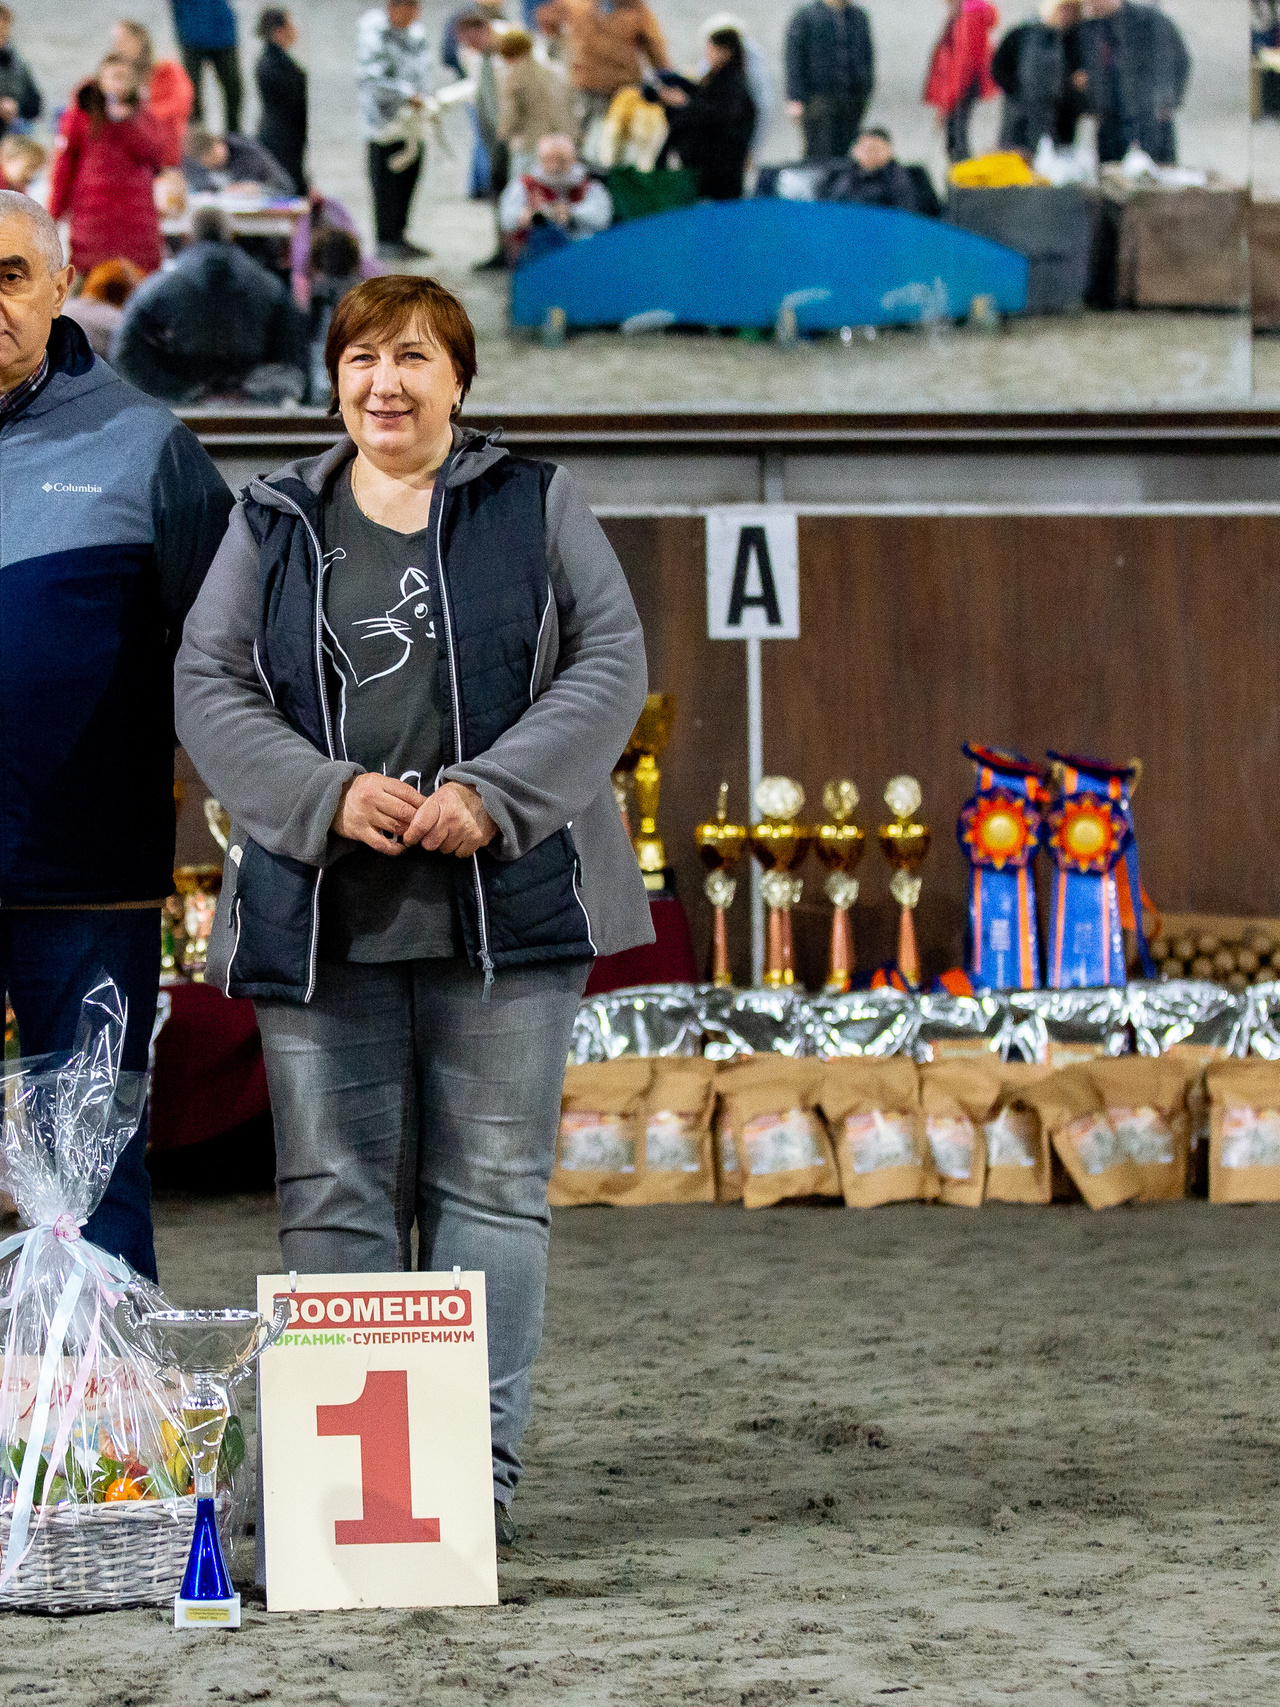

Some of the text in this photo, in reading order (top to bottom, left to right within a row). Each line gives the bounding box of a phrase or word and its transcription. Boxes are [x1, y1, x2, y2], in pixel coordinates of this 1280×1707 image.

[53, 482, 103, 493] Columbia
[727, 525, 783, 627] A
[352, 1330, 475, 1346] СУПЕРПРЕМИУМ
[316, 1370, 441, 1545] 1
